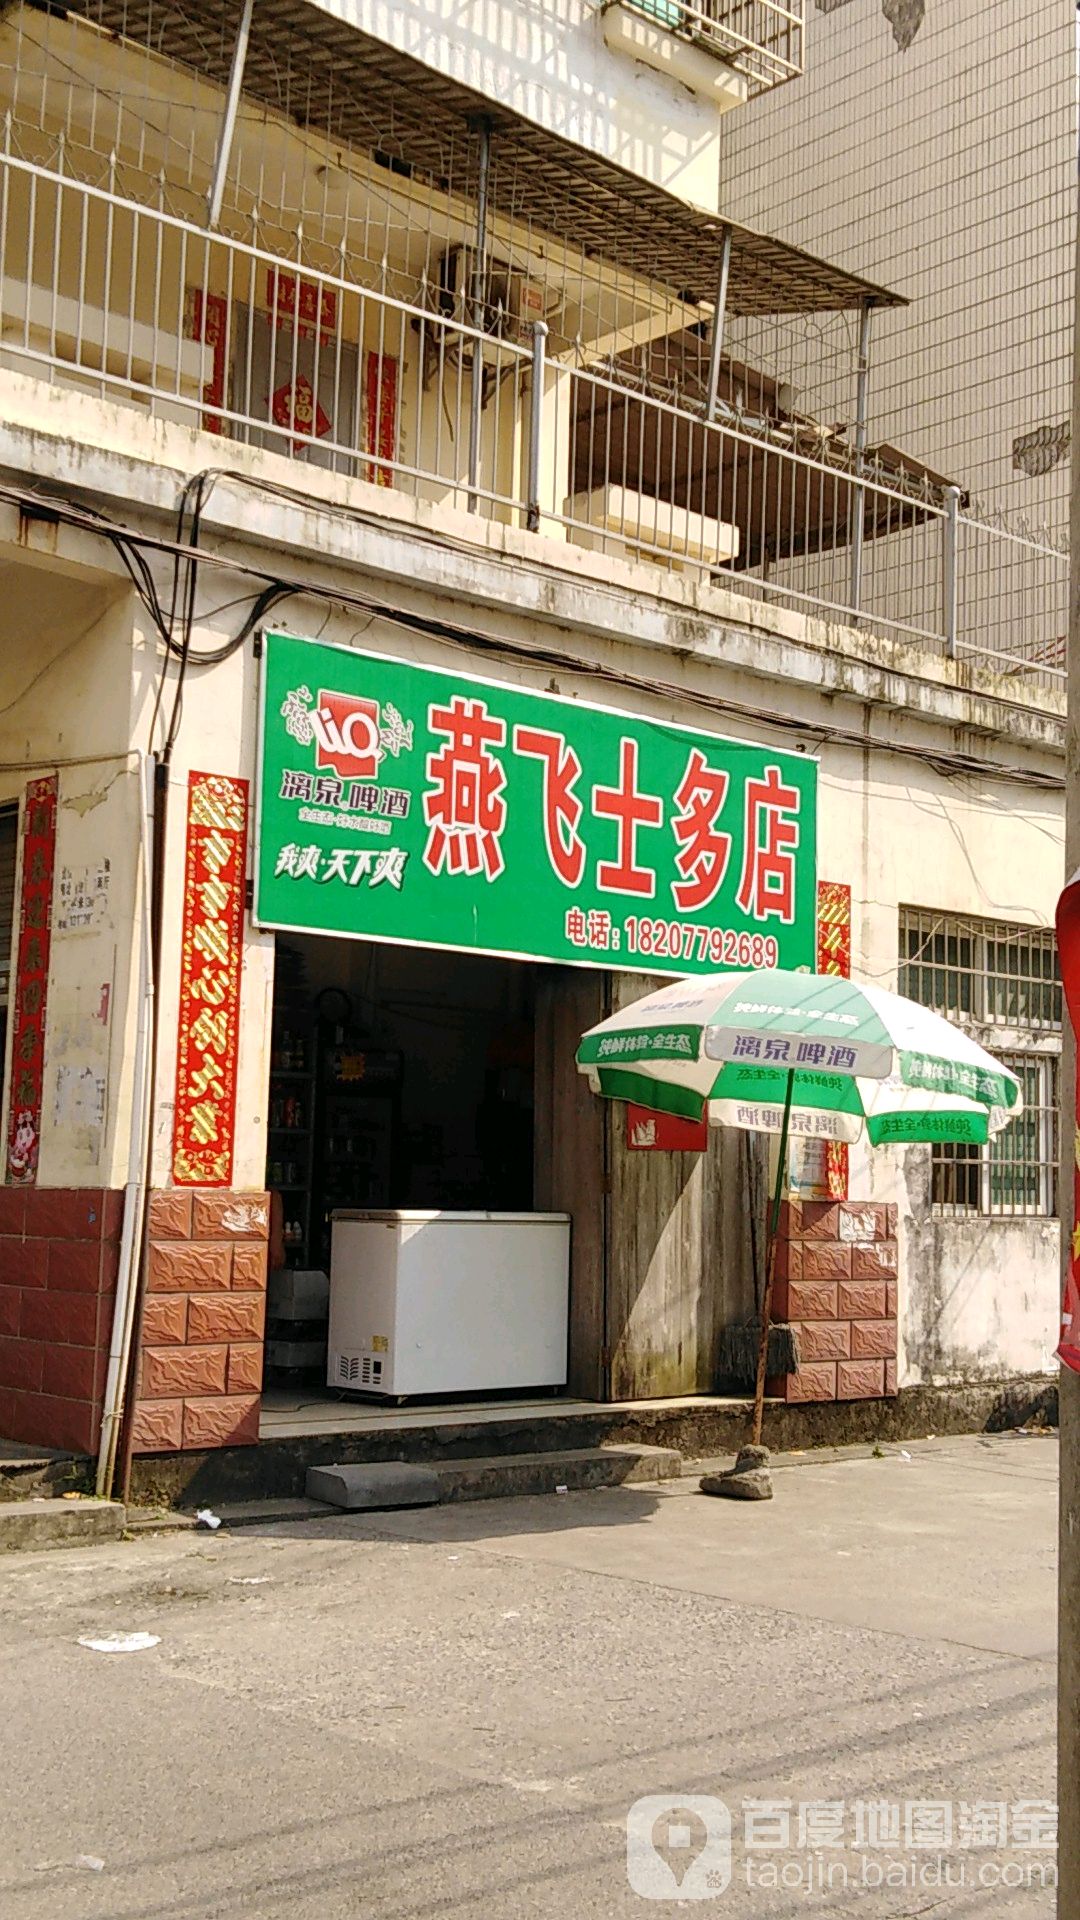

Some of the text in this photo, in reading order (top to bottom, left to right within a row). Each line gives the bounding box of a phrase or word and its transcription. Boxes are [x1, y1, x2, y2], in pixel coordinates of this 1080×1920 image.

[280, 770, 410, 818] 漓泉啤酒
[423, 695, 801, 924] 燕飞士多店
[732, 1034, 858, 1068] 漓泉啤酒
